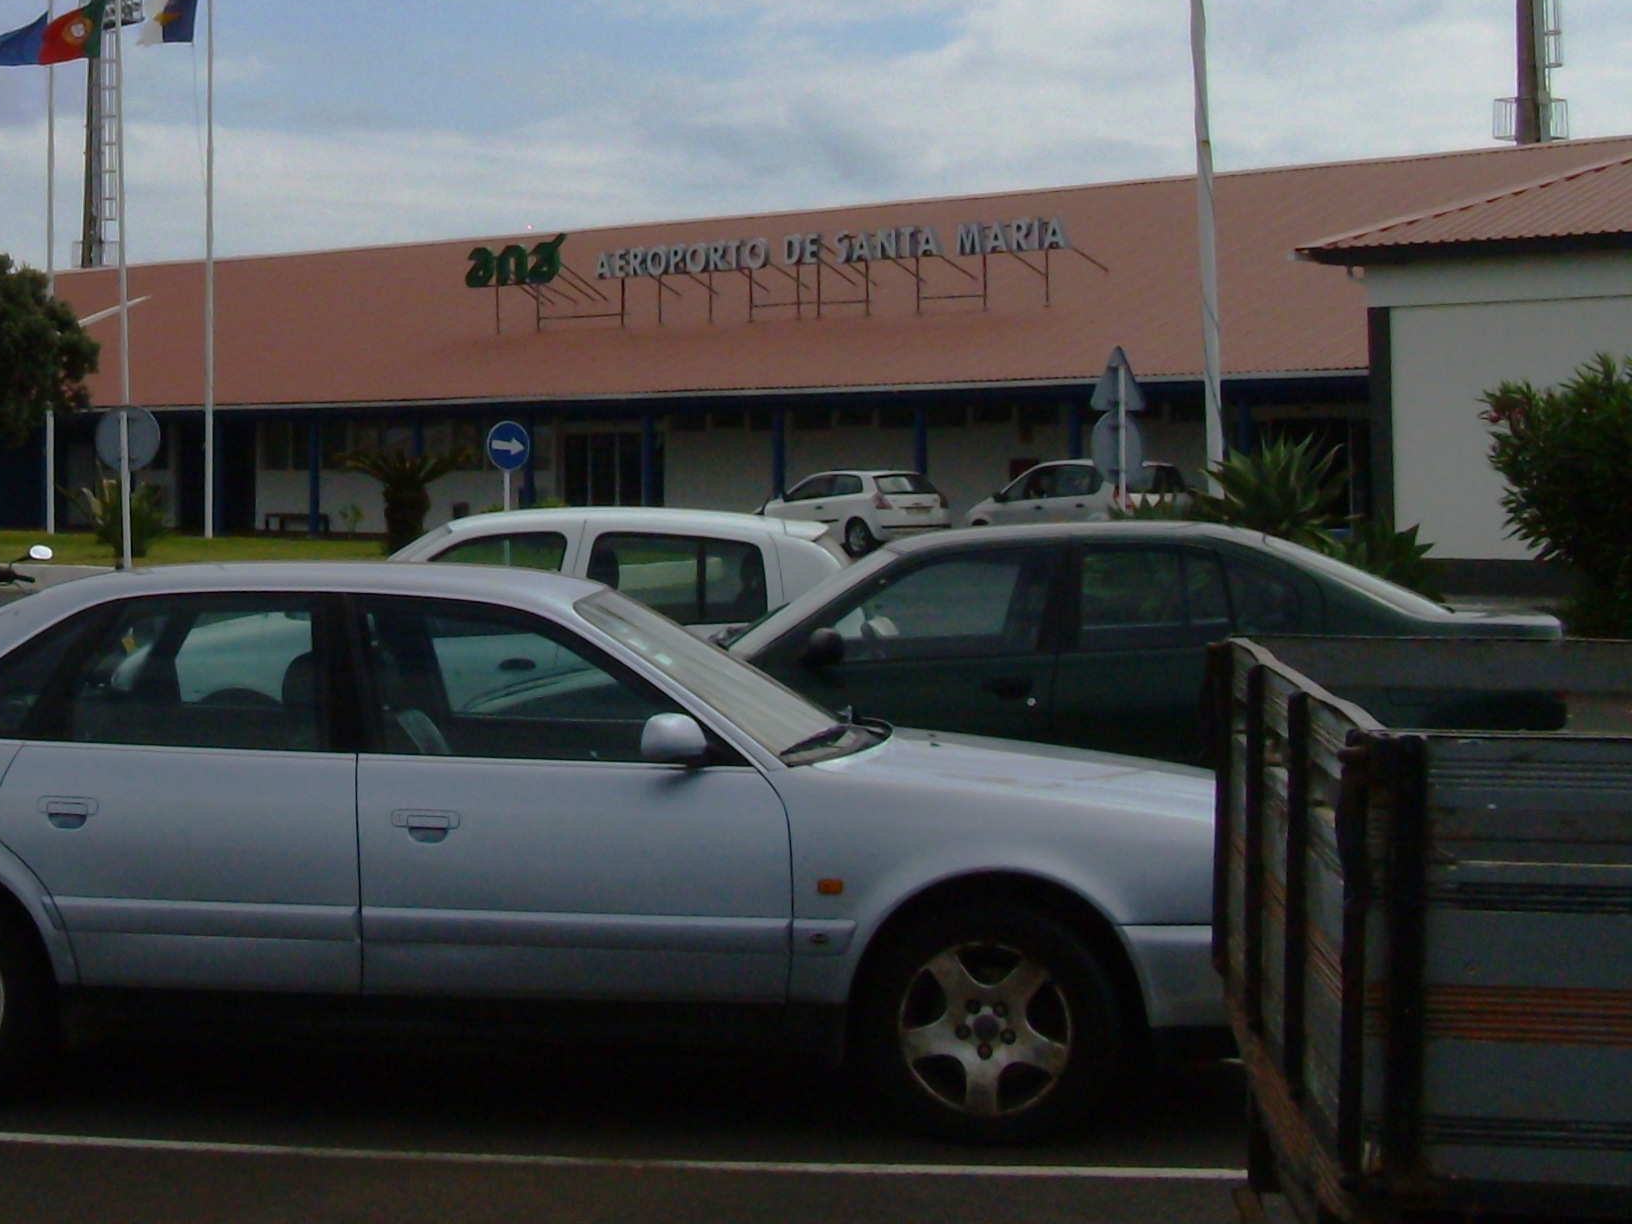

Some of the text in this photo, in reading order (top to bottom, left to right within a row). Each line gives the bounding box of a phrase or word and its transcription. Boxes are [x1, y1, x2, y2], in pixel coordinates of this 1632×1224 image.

[594, 215, 1070, 280] AEROPORTO DE SANTA MARIA
